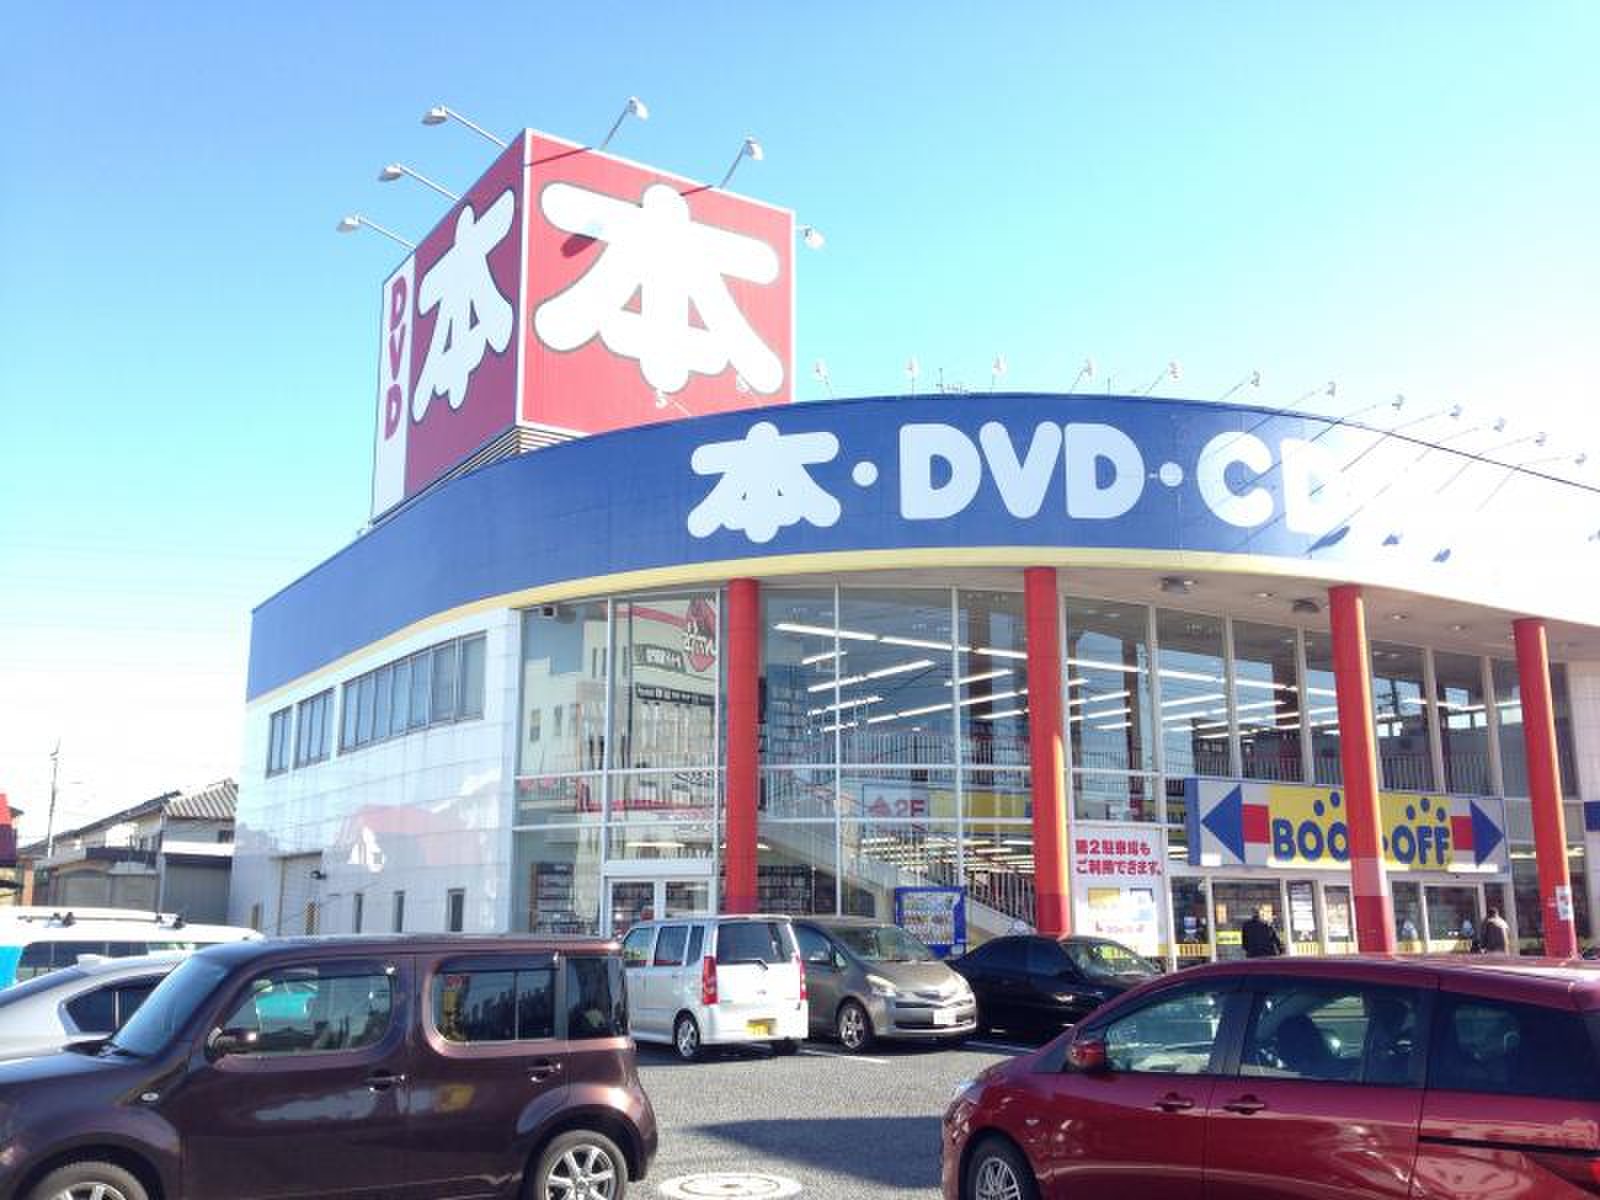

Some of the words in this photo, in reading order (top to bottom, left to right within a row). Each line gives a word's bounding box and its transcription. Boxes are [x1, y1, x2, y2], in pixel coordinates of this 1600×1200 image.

[384, 275, 408, 441] DVD
[412, 189, 515, 423] 本
[535, 183, 783, 394] 本
